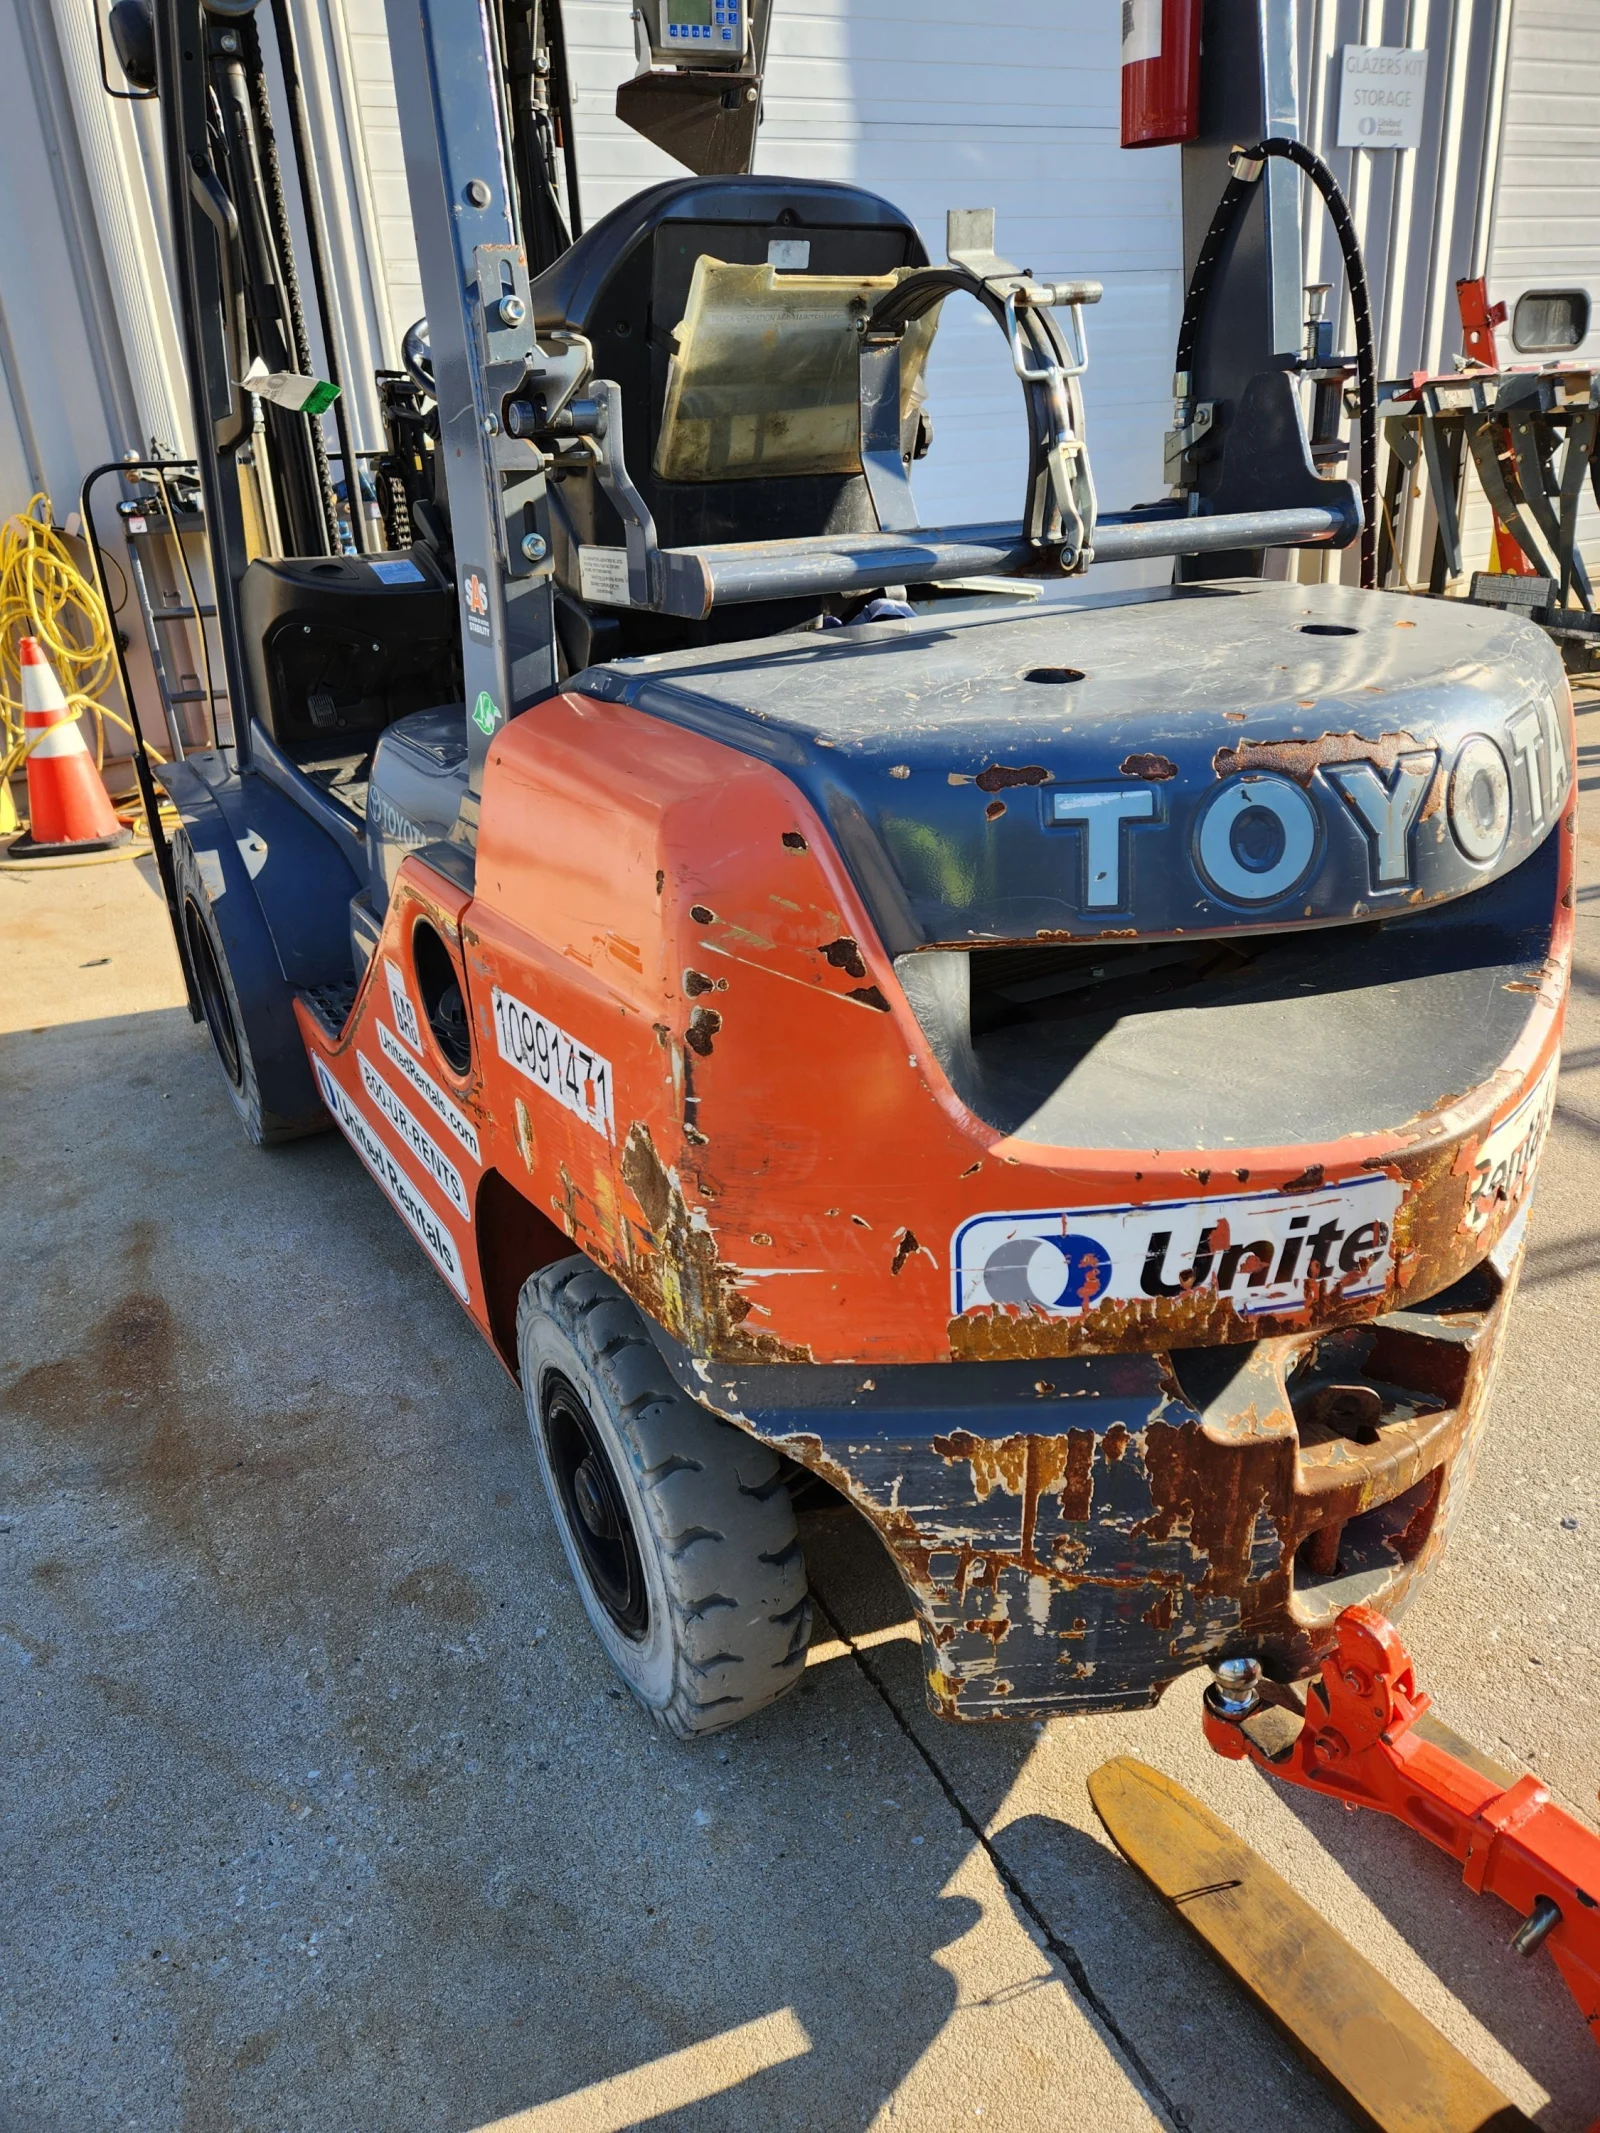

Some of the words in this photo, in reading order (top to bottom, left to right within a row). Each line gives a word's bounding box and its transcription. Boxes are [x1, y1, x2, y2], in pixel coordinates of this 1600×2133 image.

[1346, 56, 1402, 75] GLAZERS
[1405, 59, 1425, 76] KIT
[1354, 88, 1412, 107] STORAGE
[1377, 127, 1403, 137] Rentals
[1378, 117, 1402, 127] United
[464, 574, 488, 616] SAS
[469, 622, 490, 637] STABILITY
[1053, 692, 1567, 907] TOYOTA
[382, 799, 427, 847] TOYOTA
[496, 994, 609, 1120] 10991471
[380, 1027, 478, 1153] UnitedRentals.com
[337, 1091, 386, 1177] United
[387, 1157, 455, 1274] Rentals
